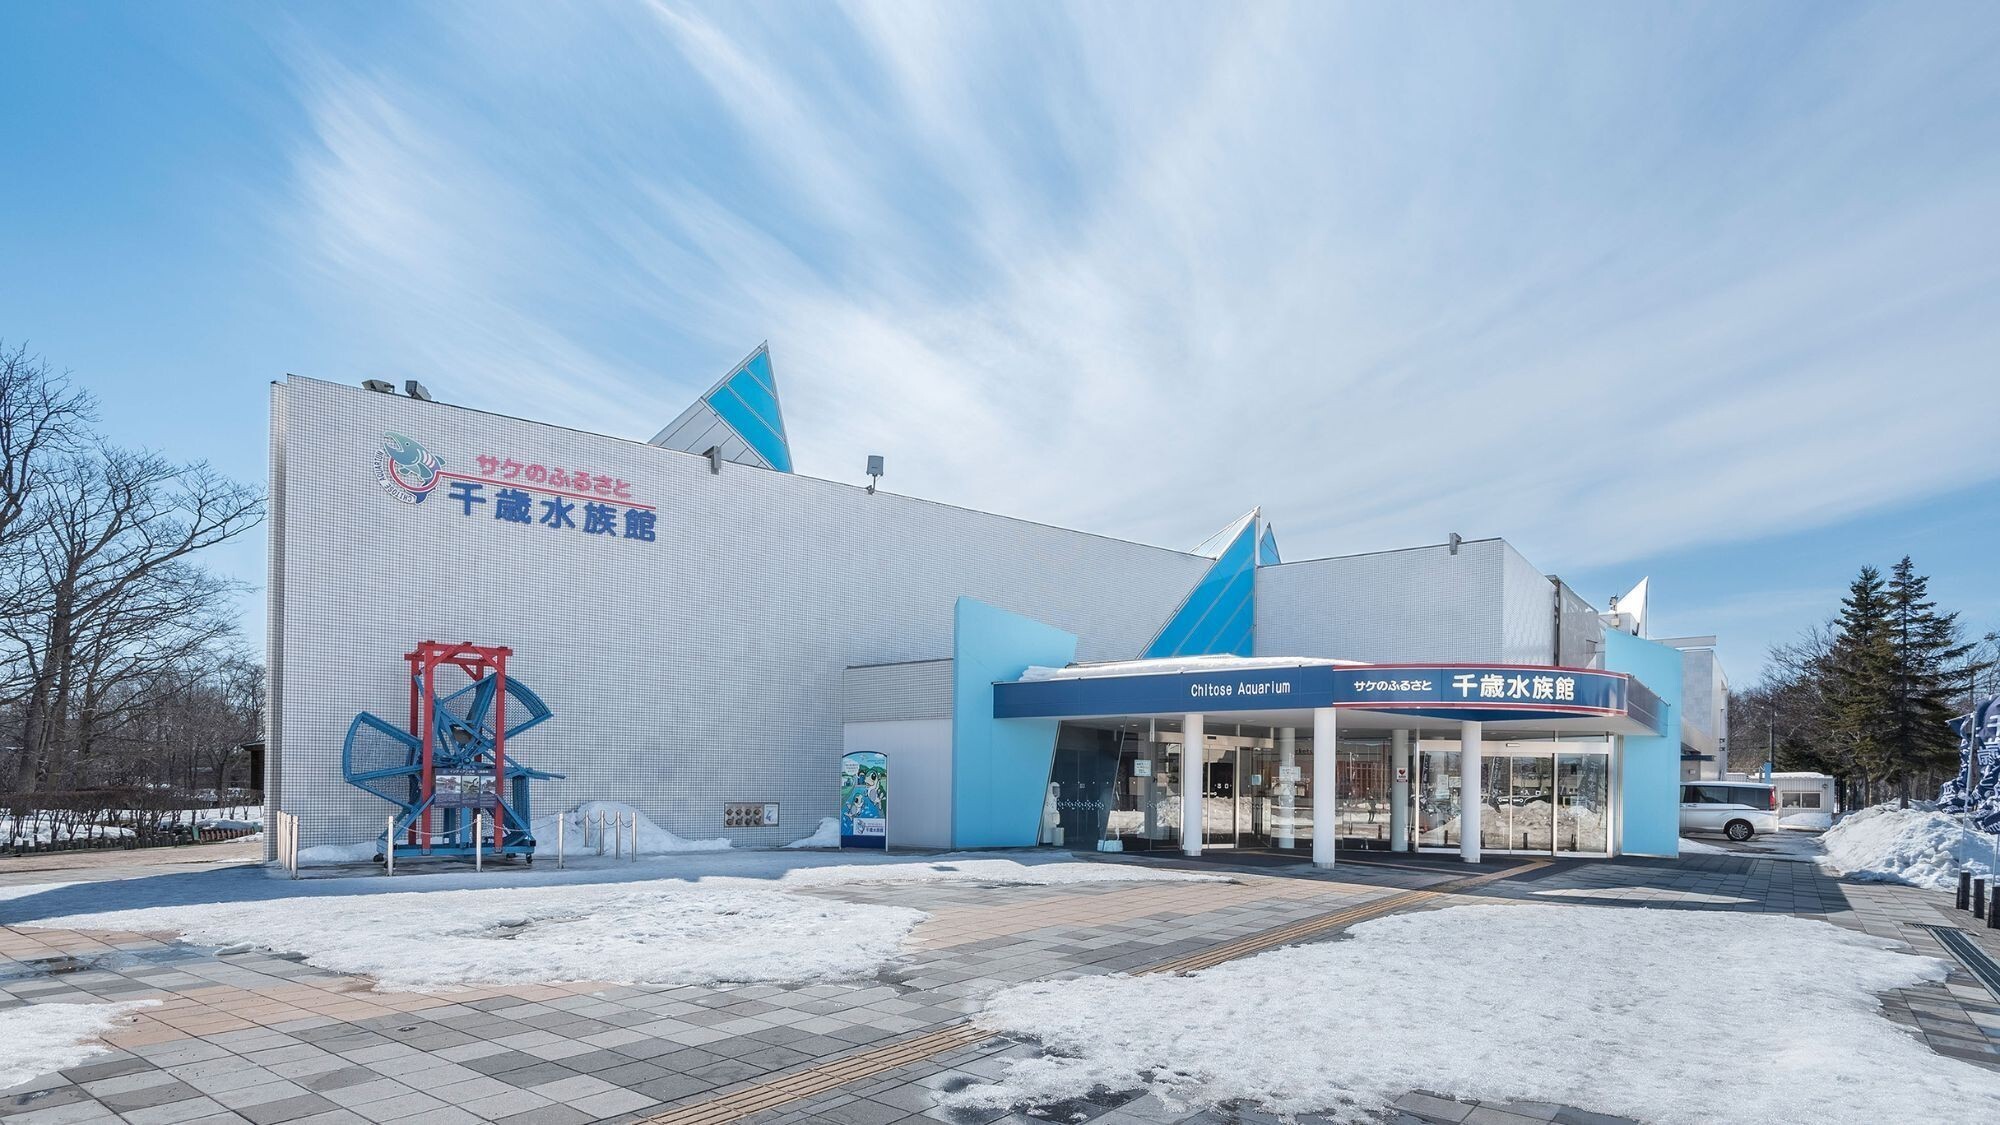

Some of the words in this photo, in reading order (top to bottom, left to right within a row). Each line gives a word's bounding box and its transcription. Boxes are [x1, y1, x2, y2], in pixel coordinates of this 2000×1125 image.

[373, 450, 387, 481] AQUARIUM
[476, 454, 632, 498] サケのふるさと
[384, 483, 413, 503] CHITOSE
[449, 481, 657, 543] 千歳水族館
[1191, 683, 1232, 697] Chitose
[1237, 681, 1291, 696] Aquarium
[1353, 679, 1432, 692] サケのふるさと
[1452, 673, 1575, 701] 千歳水族館
